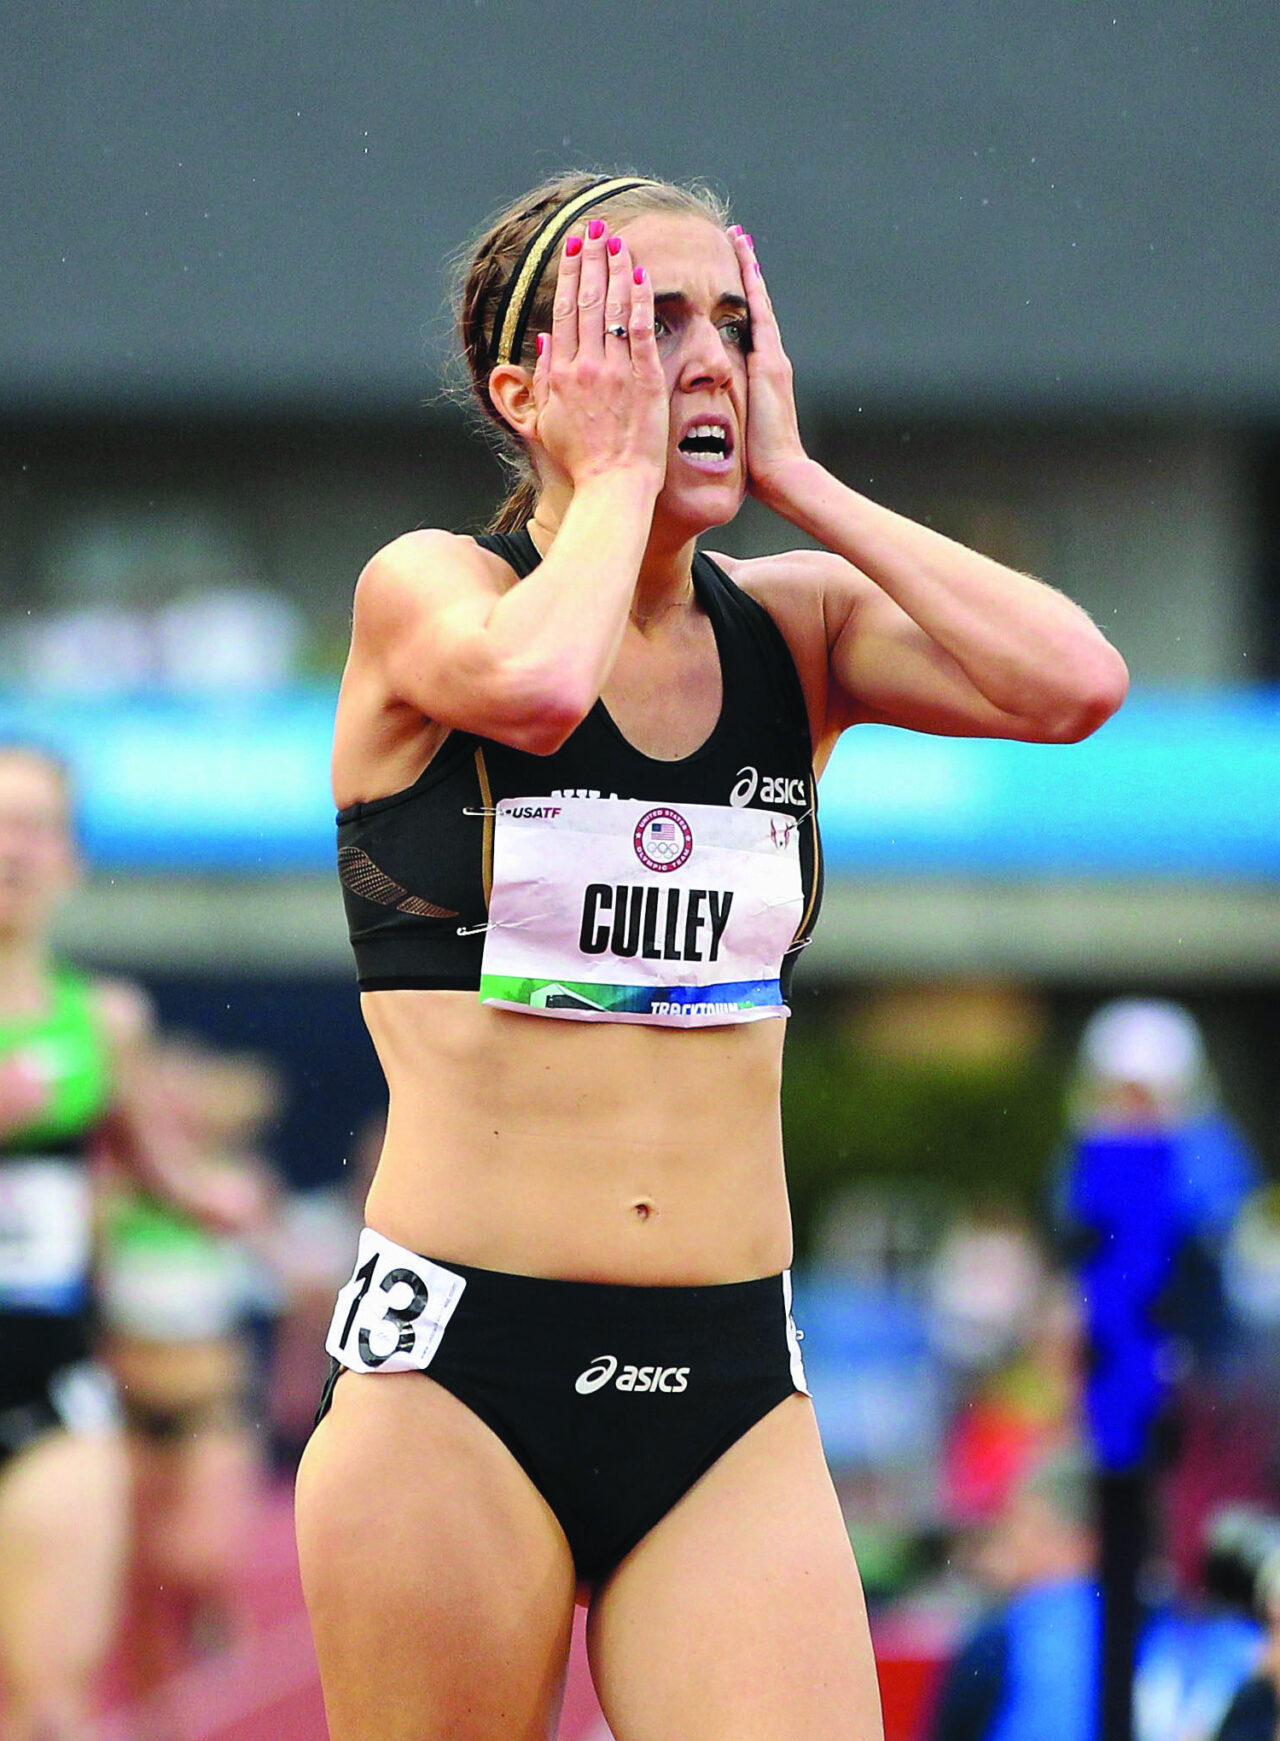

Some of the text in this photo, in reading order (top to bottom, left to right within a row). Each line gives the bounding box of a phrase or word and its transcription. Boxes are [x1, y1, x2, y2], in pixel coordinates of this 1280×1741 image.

[512, 807, 561, 819] USATF
[639, 810, 687, 830] UNITED STATES
[637, 846, 690, 871] OLYMPIC TEAM
[579, 884, 734, 962] CULLEY
[339, 1252, 428, 1367] 13
[615, 1365, 690, 1392] asics
